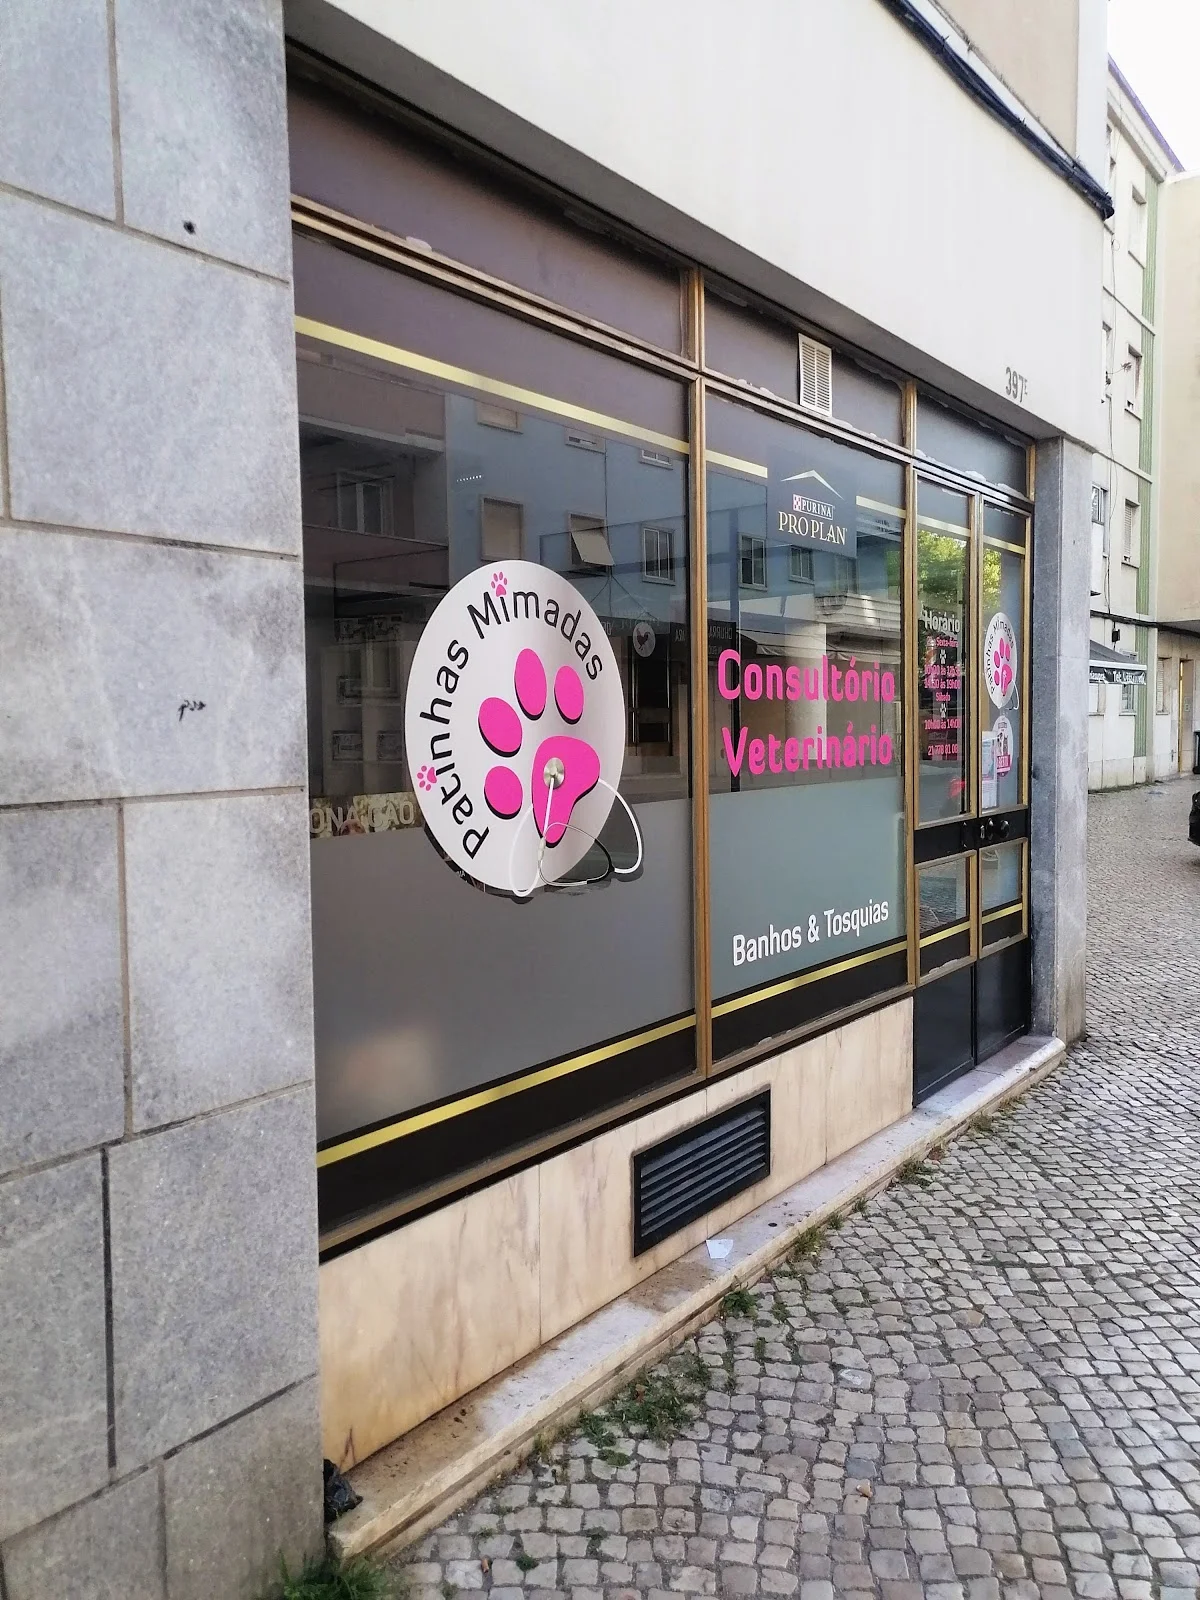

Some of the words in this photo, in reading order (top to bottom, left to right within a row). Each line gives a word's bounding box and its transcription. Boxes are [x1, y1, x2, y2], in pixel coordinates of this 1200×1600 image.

[778, 511, 808, 536] PRO
[811, 519, 846, 545] PLAN
[801, 499, 832, 518] PURINA
[924, 610, 960, 633] Horário
[717, 648, 896, 703] Consultório
[419, 638, 489, 860] Patinhas
[467, 587, 606, 681] Mimadas
[721, 720, 894, 777] Veterinário
[732, 923, 802, 967] Banhos
[807, 914, 821, 944] &
[823, 898, 889, 938] Tosquias
